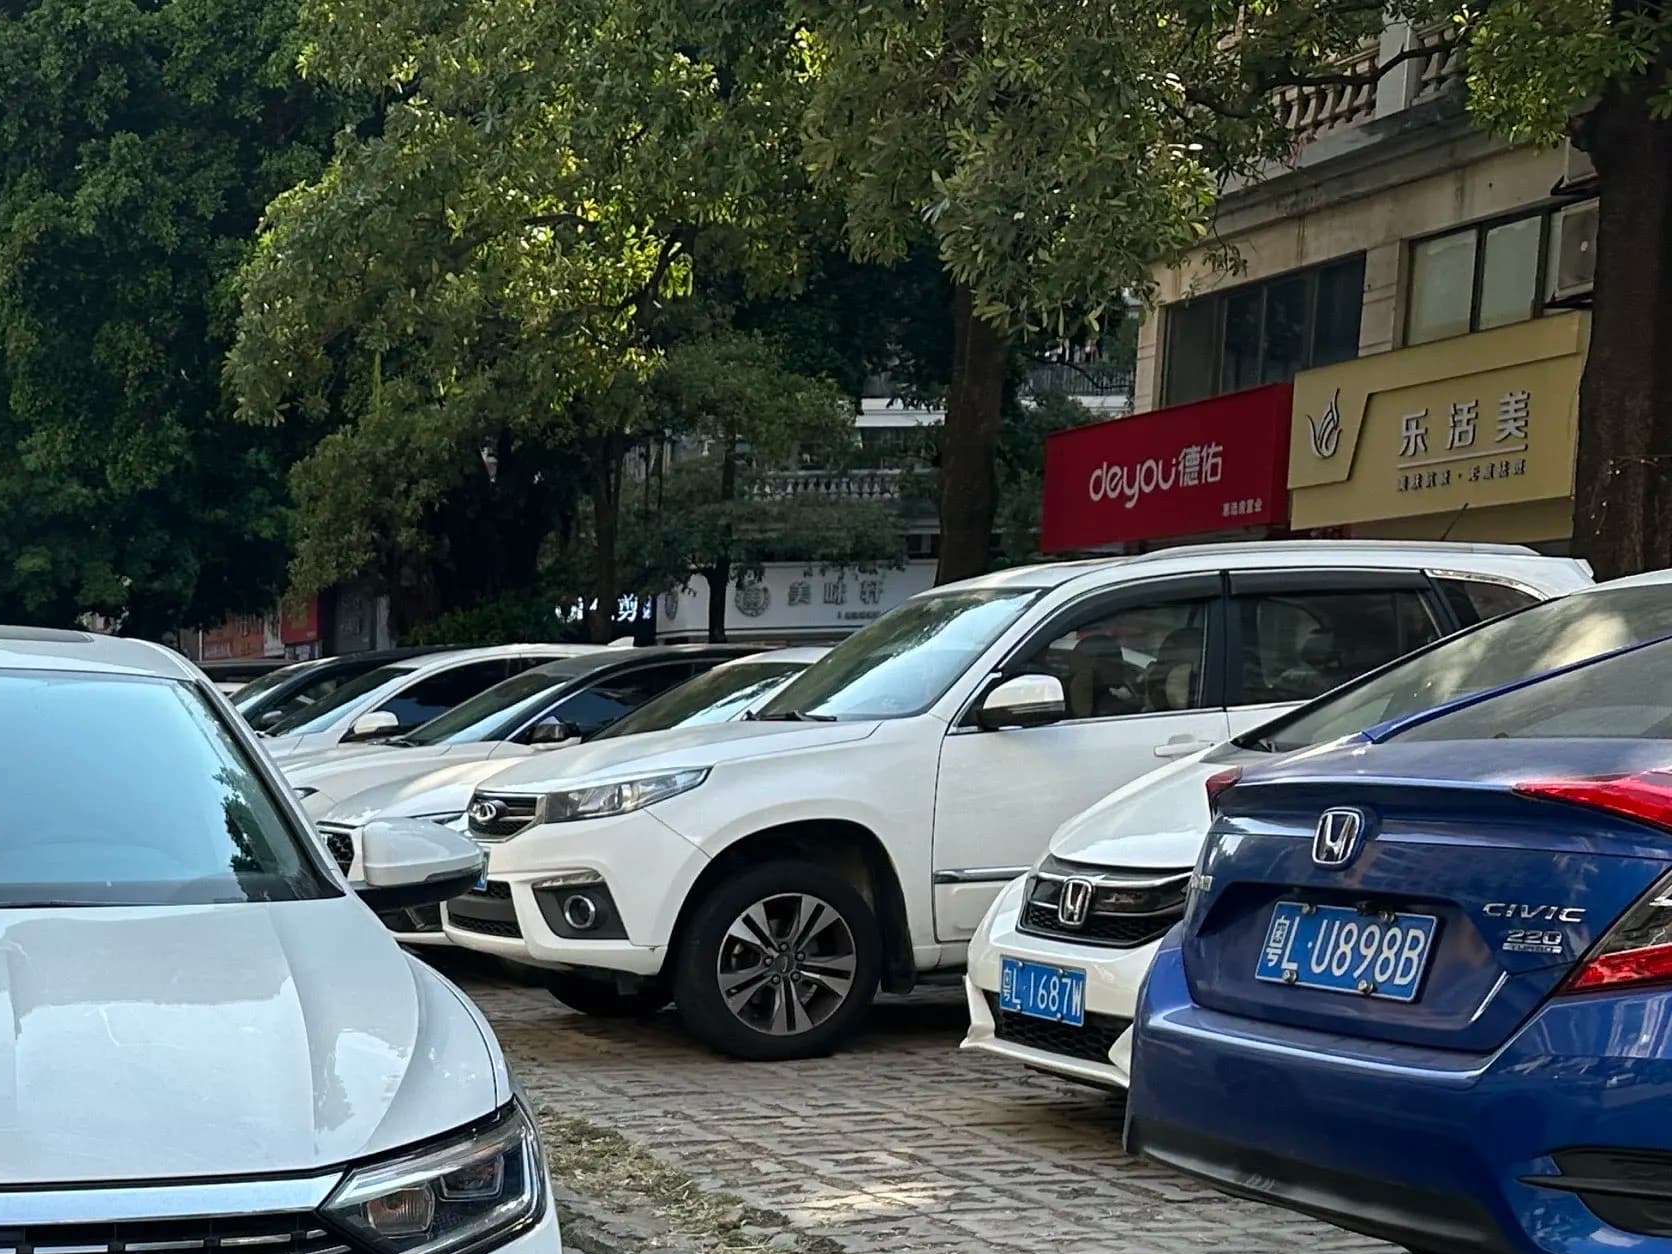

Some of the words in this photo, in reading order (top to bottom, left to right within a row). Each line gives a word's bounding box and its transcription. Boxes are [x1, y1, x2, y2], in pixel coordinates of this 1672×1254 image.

[1399, 390, 1530, 457] 乐活美
[1089, 457, 1177, 509] deyou
[1178, 441, 1224, 488] 德佑
[1481, 902, 1586, 923] CIVIC
[1506, 929, 1563, 945] 220
